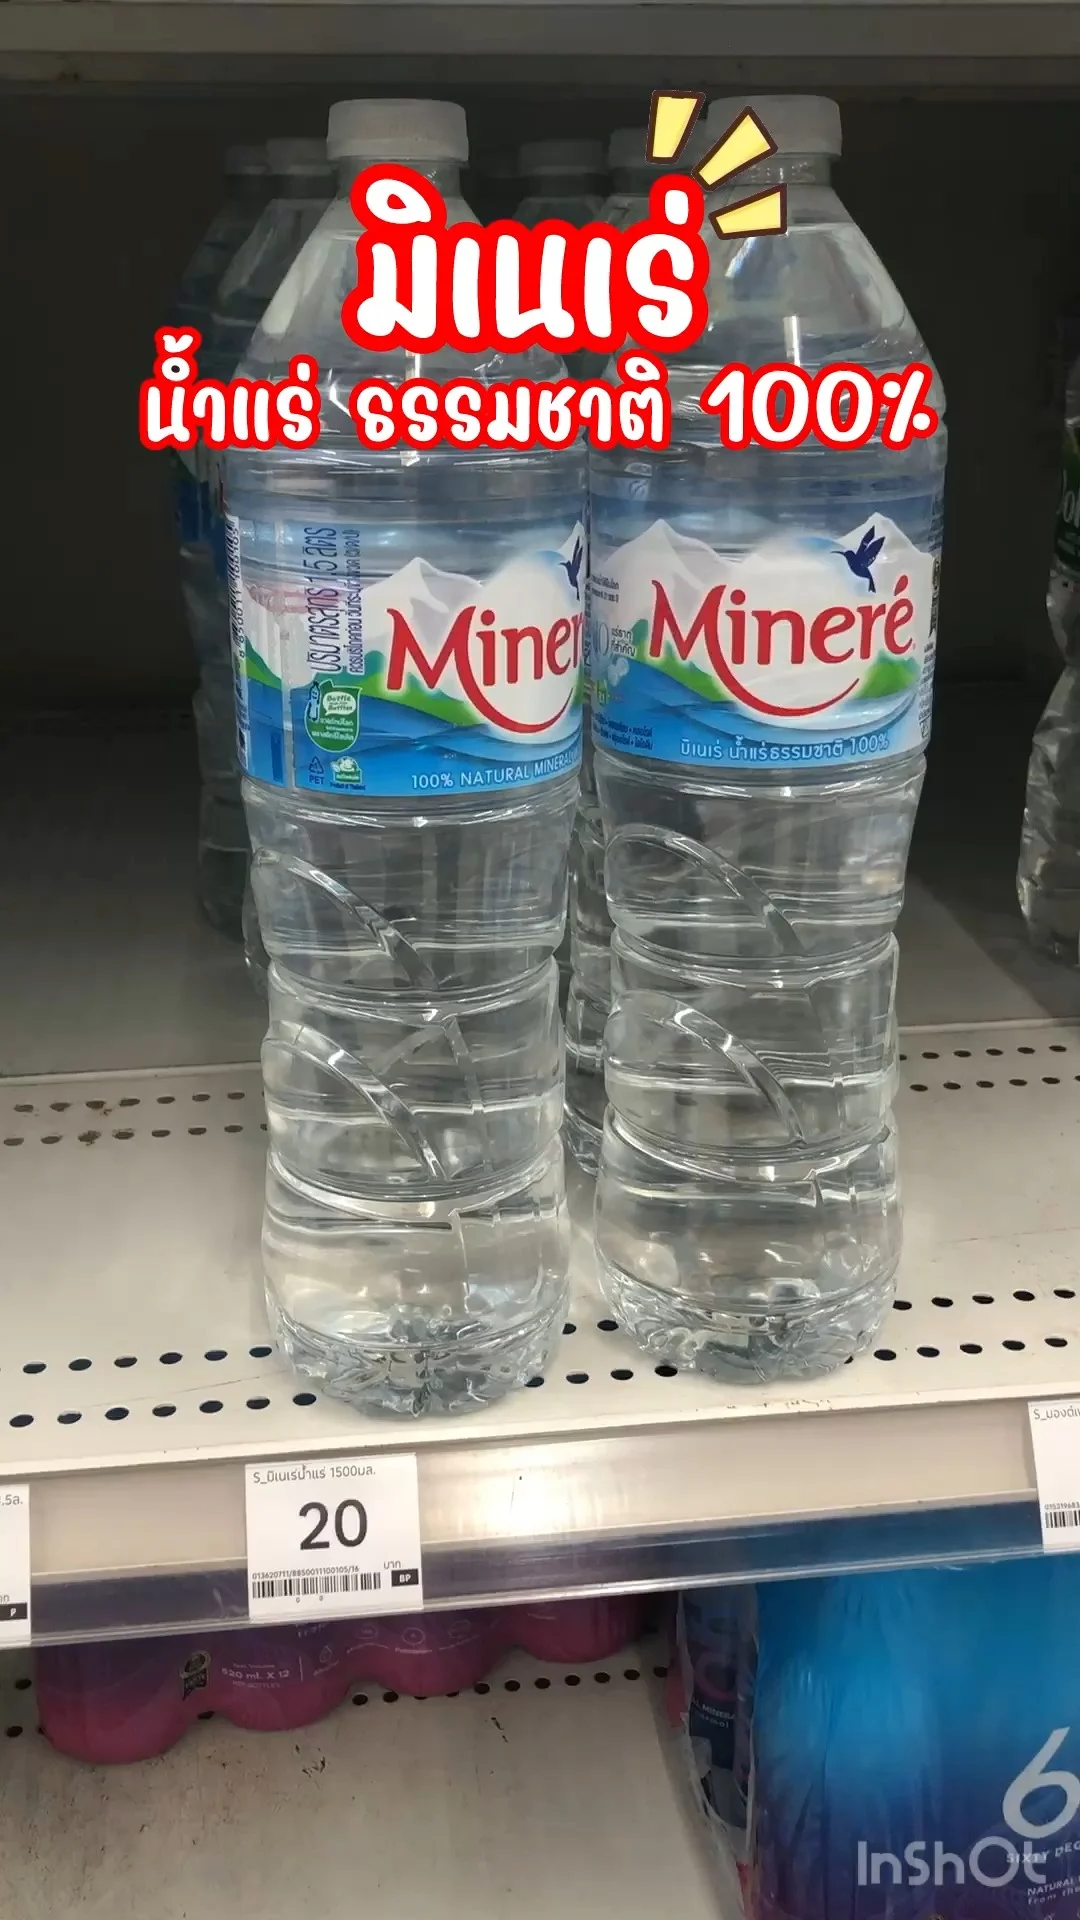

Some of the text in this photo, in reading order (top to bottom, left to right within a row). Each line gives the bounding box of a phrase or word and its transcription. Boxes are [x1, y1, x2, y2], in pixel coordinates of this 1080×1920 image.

[649, 574, 915, 717] Mineré
[680, 738, 723, 759] มิเนเร่
[849, 732, 890, 756] 100%
[309, 775, 325, 785] PET
[411, 773, 455, 789] 100%
[460, 767, 530, 787] NATURAL
[330, 1465, 377, 1479] 1500มล.
[298, 1498, 369, 1551] 20
[383, 1559, 402, 1571] บาท
[400, 1573, 412, 1583] BP
[1027, 1876, 1074, 1896] NATURAL
[1027, 1893, 1057, 1905] from
